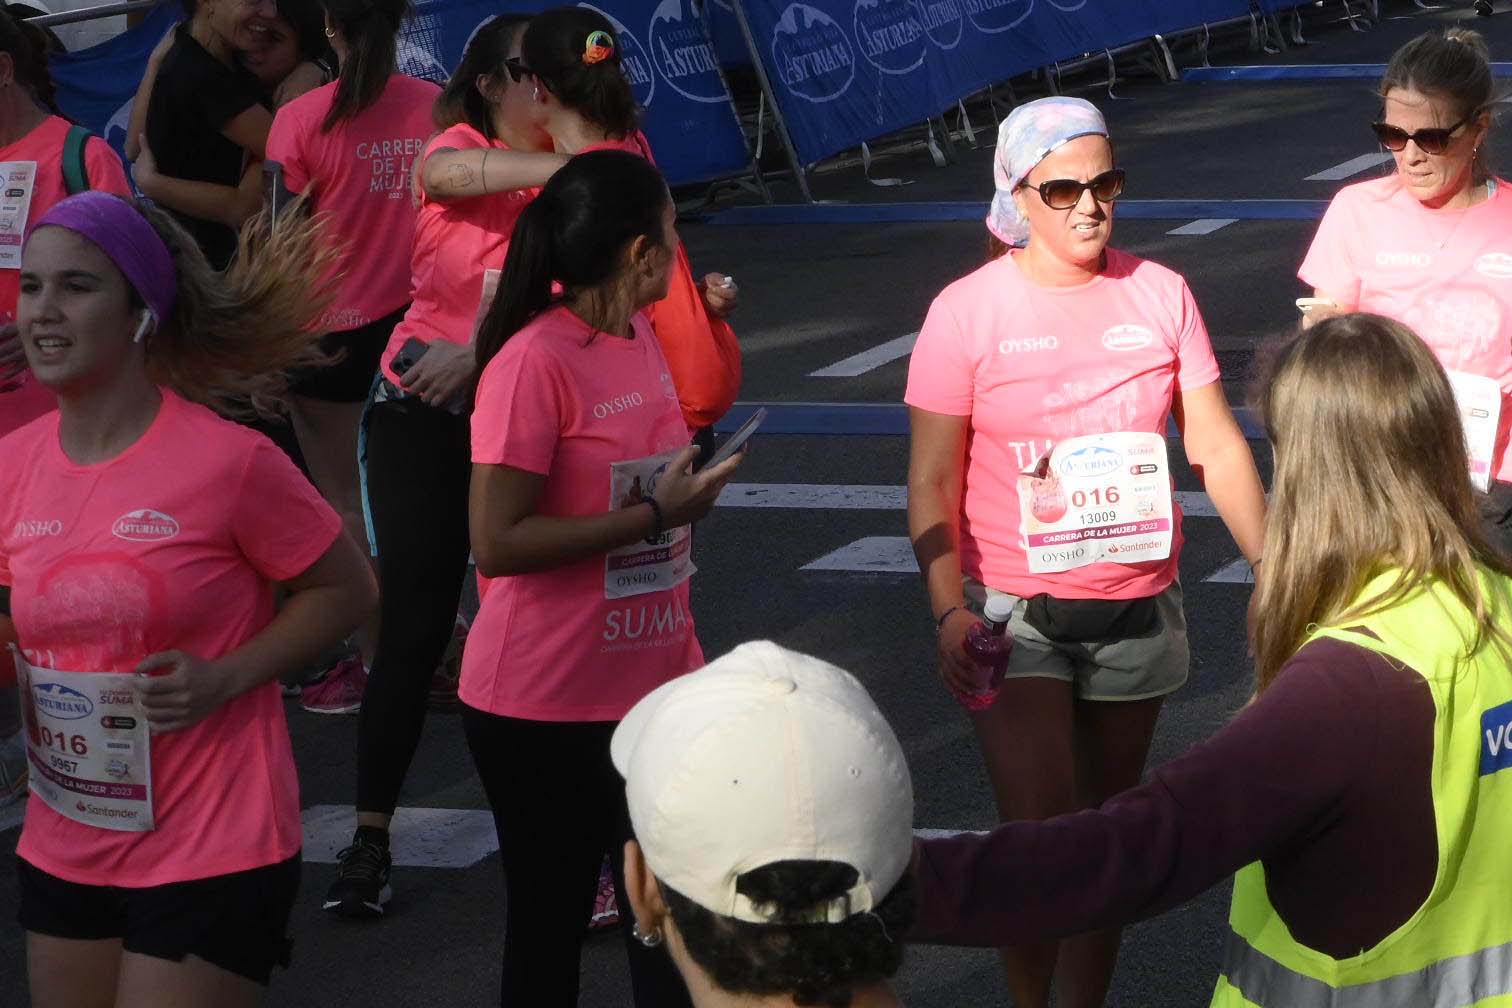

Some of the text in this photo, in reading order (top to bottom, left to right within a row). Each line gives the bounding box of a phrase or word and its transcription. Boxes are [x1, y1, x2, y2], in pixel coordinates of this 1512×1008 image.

[356, 138, 423, 160] CARRER
[373, 156, 409, 175] DE L
[370, 173, 411, 193] MUJE
[1000, 335, 1058, 354] OYSHO
[593, 391, 643, 420] OYSHO
[1071, 486, 1120, 508] 016
[1079, 510, 1116, 525] 13009
[117, 521, 174, 537] ASTURIANA
[1043, 532, 1083, 543] CARRERA
[1084, 530, 1096, 538] DE
[1097, 528, 1109, 537] LA
[1109, 525, 1137, 536] MUJER
[1042, 540, 1162, 563] OYSHO Santander
[617, 572, 657, 587] OYSHO
[603, 596, 687, 641] SUMA
[100, 695, 134, 705] SUMA
[41, 726, 88, 755] 016
[50, 755, 78, 773] 9967
[76, 782, 107, 795] MUJER
[87, 803, 138, 819] Santander
